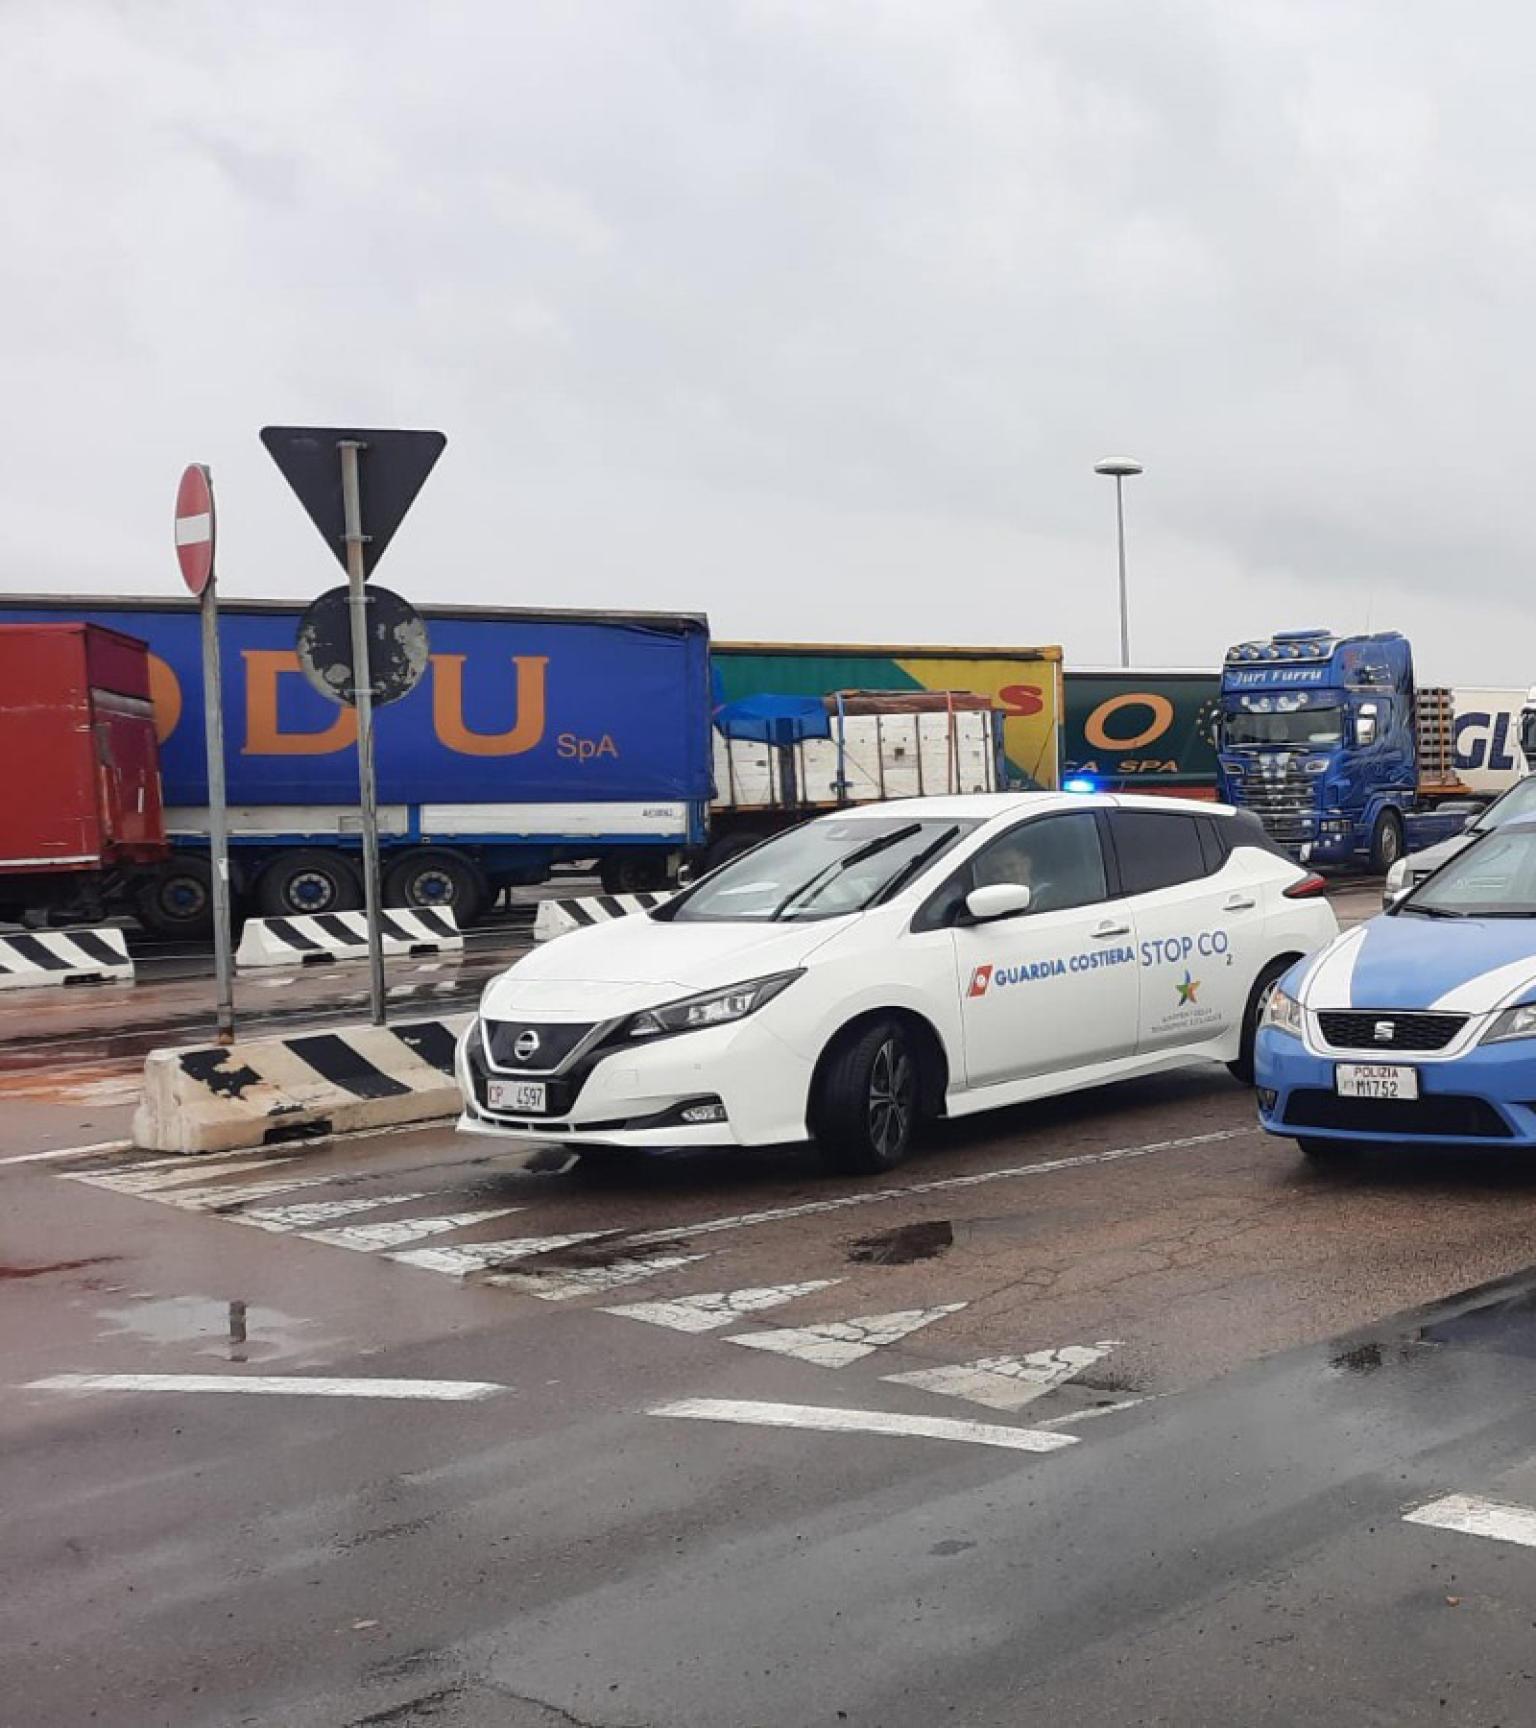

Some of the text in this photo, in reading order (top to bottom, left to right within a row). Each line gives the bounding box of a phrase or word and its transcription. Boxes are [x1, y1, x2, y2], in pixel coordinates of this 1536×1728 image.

[557, 733, 619, 763] SpA
[1117, 759, 1178, 773] SPA
[994, 946, 1136, 986] GUARDIA COSTIERA
[1141, 936, 1193, 967] STOP
[1354, 1066, 1399, 1079] POLIZIA
